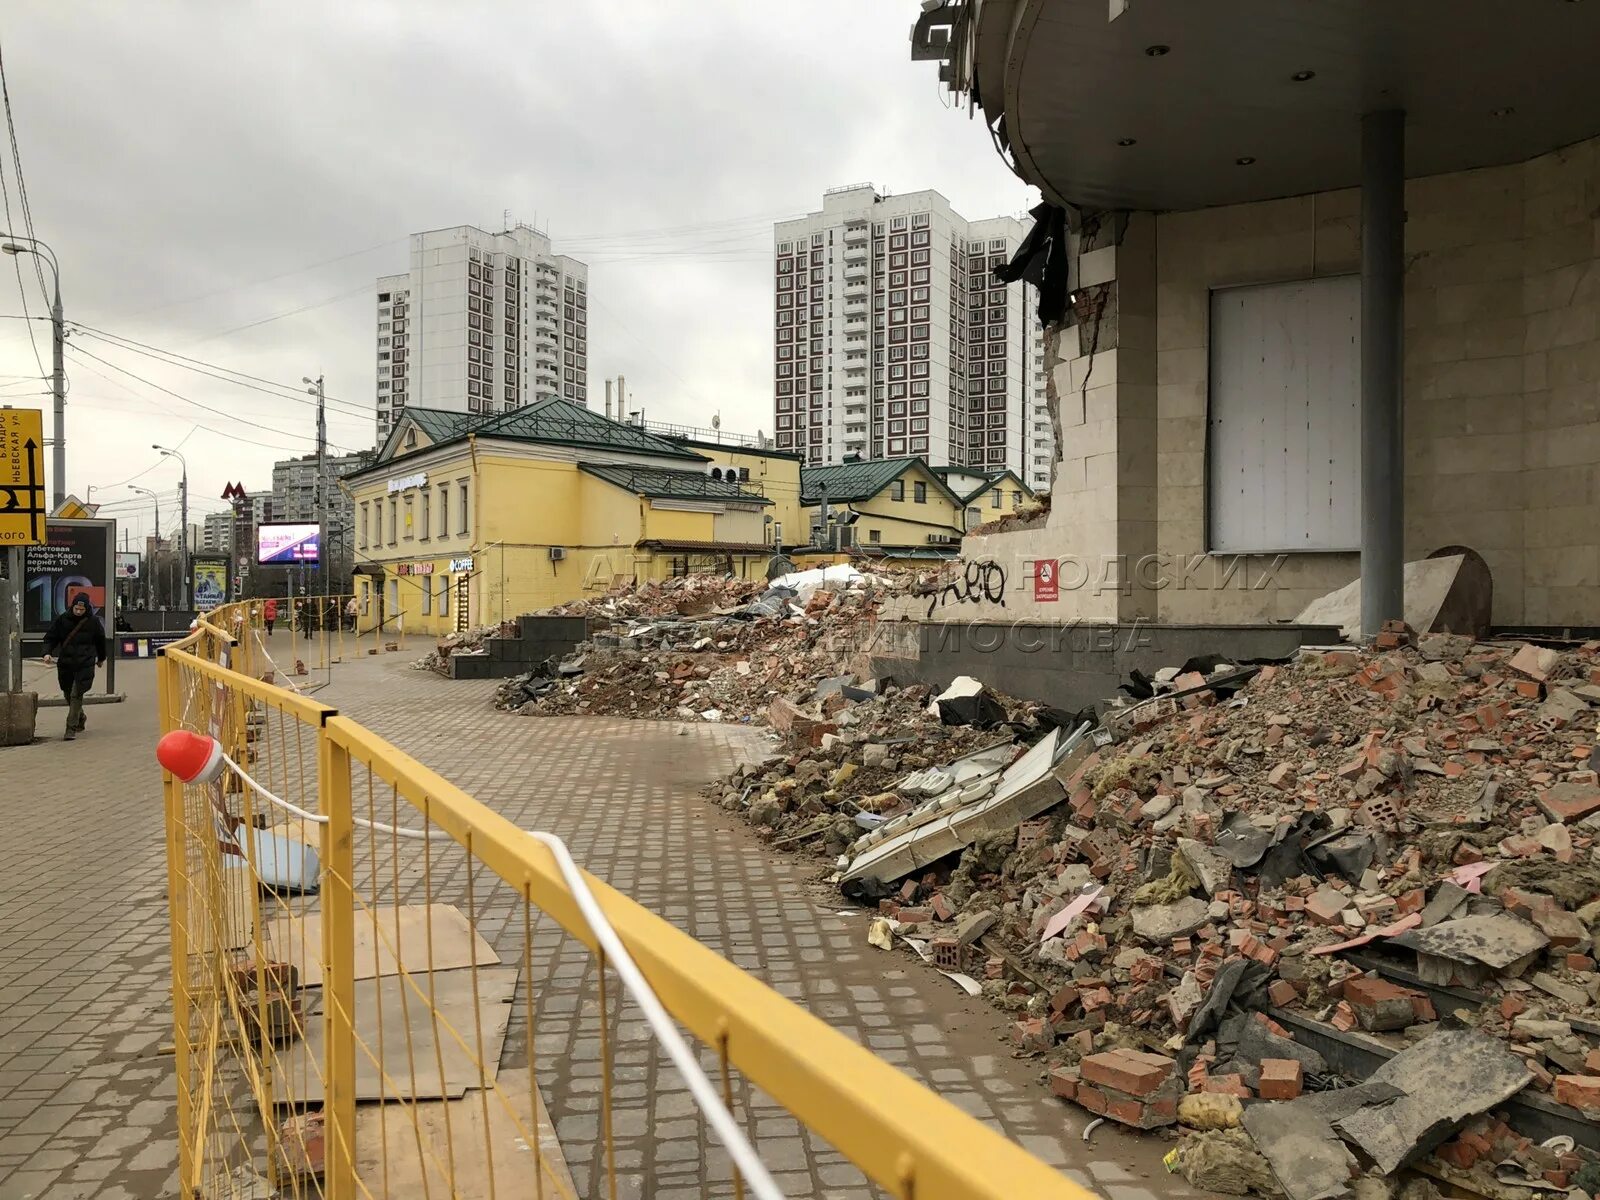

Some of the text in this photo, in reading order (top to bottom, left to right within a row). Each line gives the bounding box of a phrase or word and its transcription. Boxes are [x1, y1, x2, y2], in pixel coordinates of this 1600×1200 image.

[11, 413, 20, 483] НЬЕВСКАЯ ул.
[27, 559, 56, 567] вернёт
